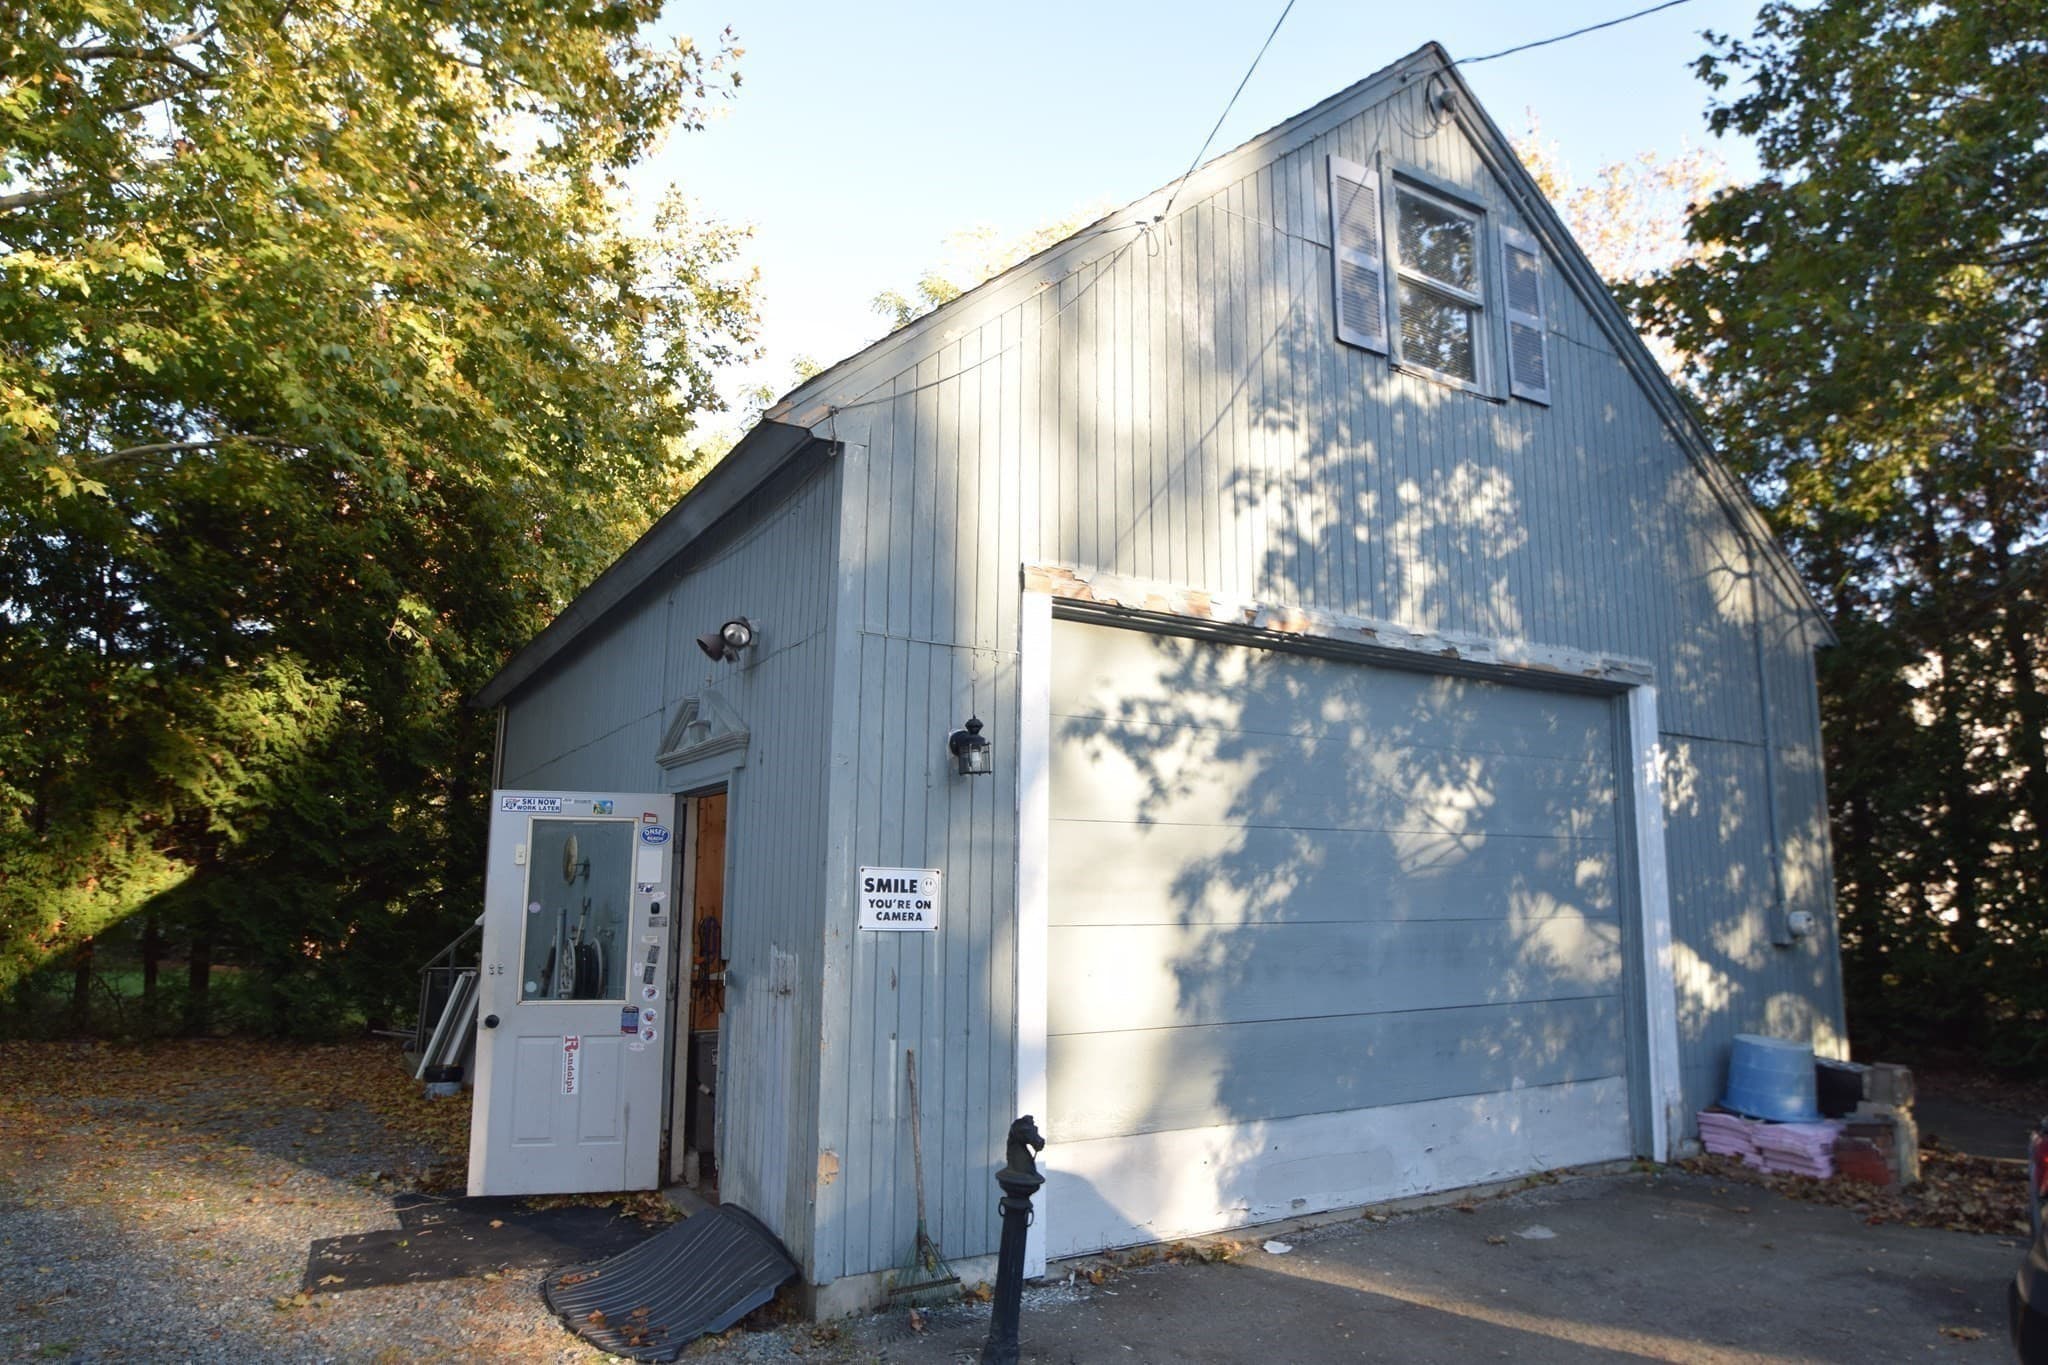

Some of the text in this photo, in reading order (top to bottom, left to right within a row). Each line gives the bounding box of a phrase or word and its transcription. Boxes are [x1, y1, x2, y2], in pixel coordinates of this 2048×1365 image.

[644, 827, 666, 836] ONSET
[864, 877, 918, 893] SMILE
[868, 899, 931, 909] YOU'RE ON
[876, 911, 922, 921] CAMERA
[564, 1035, 579, 1093] Randolph
